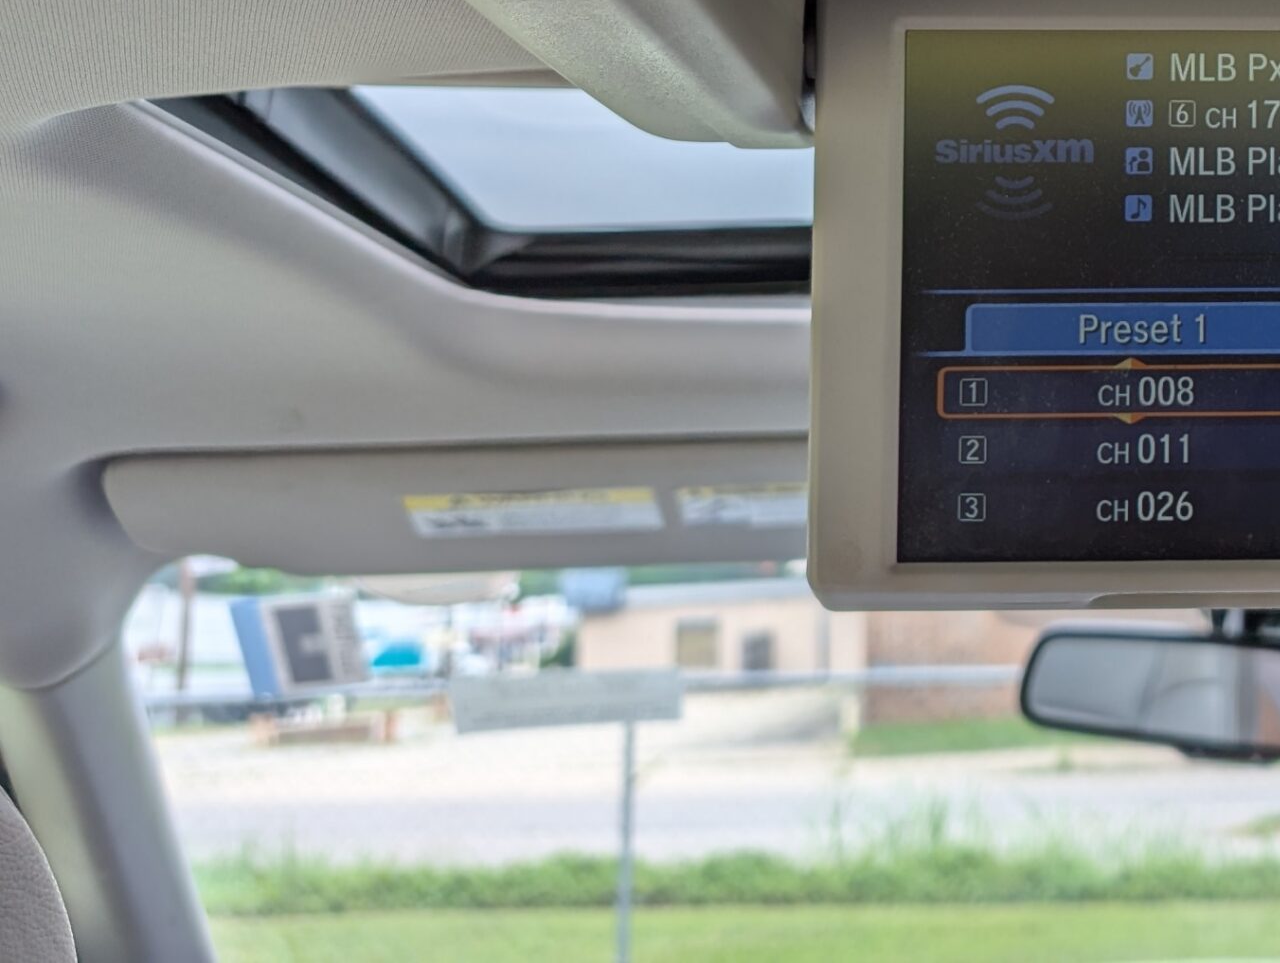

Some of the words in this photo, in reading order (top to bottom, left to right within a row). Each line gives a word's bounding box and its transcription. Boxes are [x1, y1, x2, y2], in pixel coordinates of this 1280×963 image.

[1170, 53, 1236, 82] MLB
[1176, 104, 1189, 124] 6
[1205, 108, 1237, 129] CH
[1169, 147, 1236, 176] MLB
[1169, 194, 1236, 223] MLB
[1079, 314, 1182, 344] Preset
[1195, 314, 1206, 343] 1
[1098, 385, 1131, 406] CH
[1139, 376, 1195, 406] 008
[965, 439, 980, 461] 2
[1097, 442, 1130, 464] CH
[1137, 434, 1190, 464] 011
[964, 496, 979, 519] 3
[1096, 499, 1129, 521] CH
[1137, 491, 1194, 521] 026
